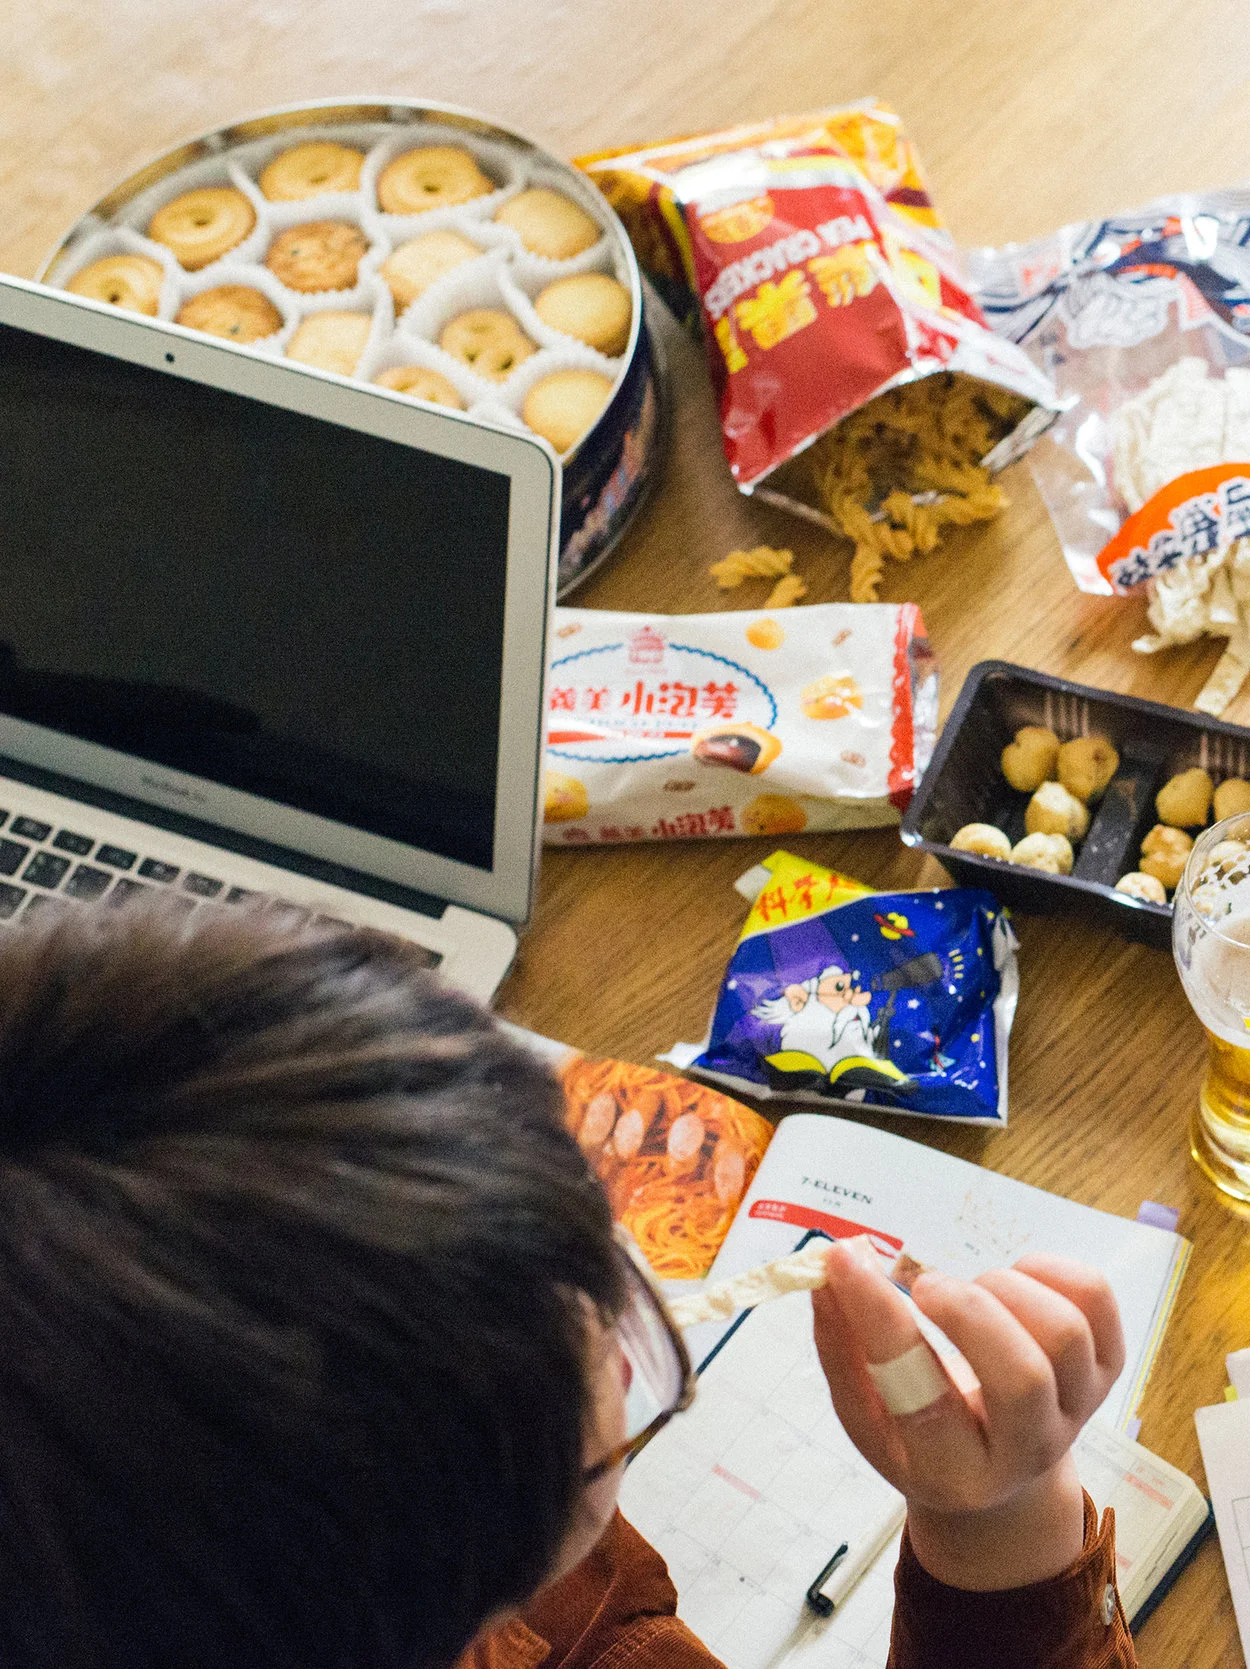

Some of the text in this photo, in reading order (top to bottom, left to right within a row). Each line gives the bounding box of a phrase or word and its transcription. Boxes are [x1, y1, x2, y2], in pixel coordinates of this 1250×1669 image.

[621, 680, 740, 719] 小泡芙
[801, 1176, 873, 1205] 7-ELEVEN
